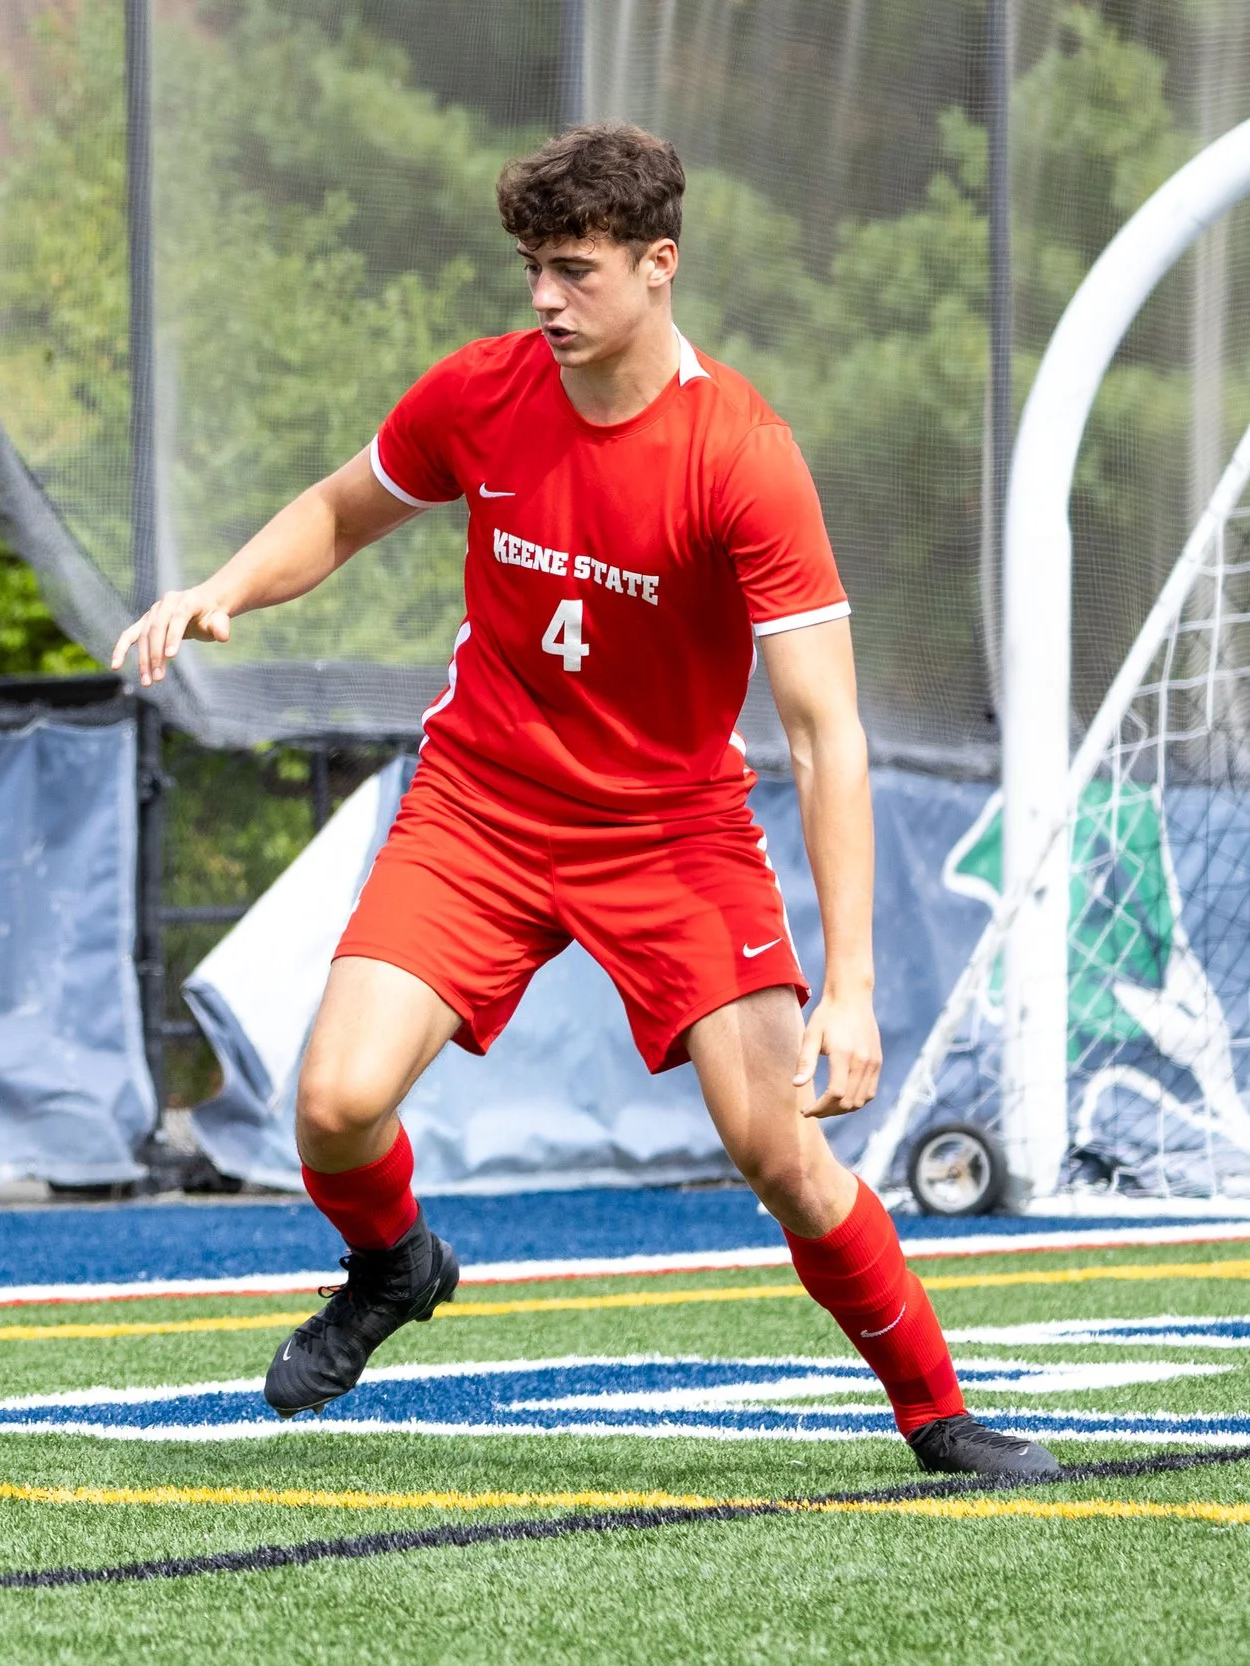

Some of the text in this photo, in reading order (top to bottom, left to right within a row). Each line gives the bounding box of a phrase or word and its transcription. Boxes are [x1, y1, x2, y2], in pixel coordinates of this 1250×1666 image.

[493, 528, 660, 606] KEENE STATE
[541, 599, 590, 672] 4
